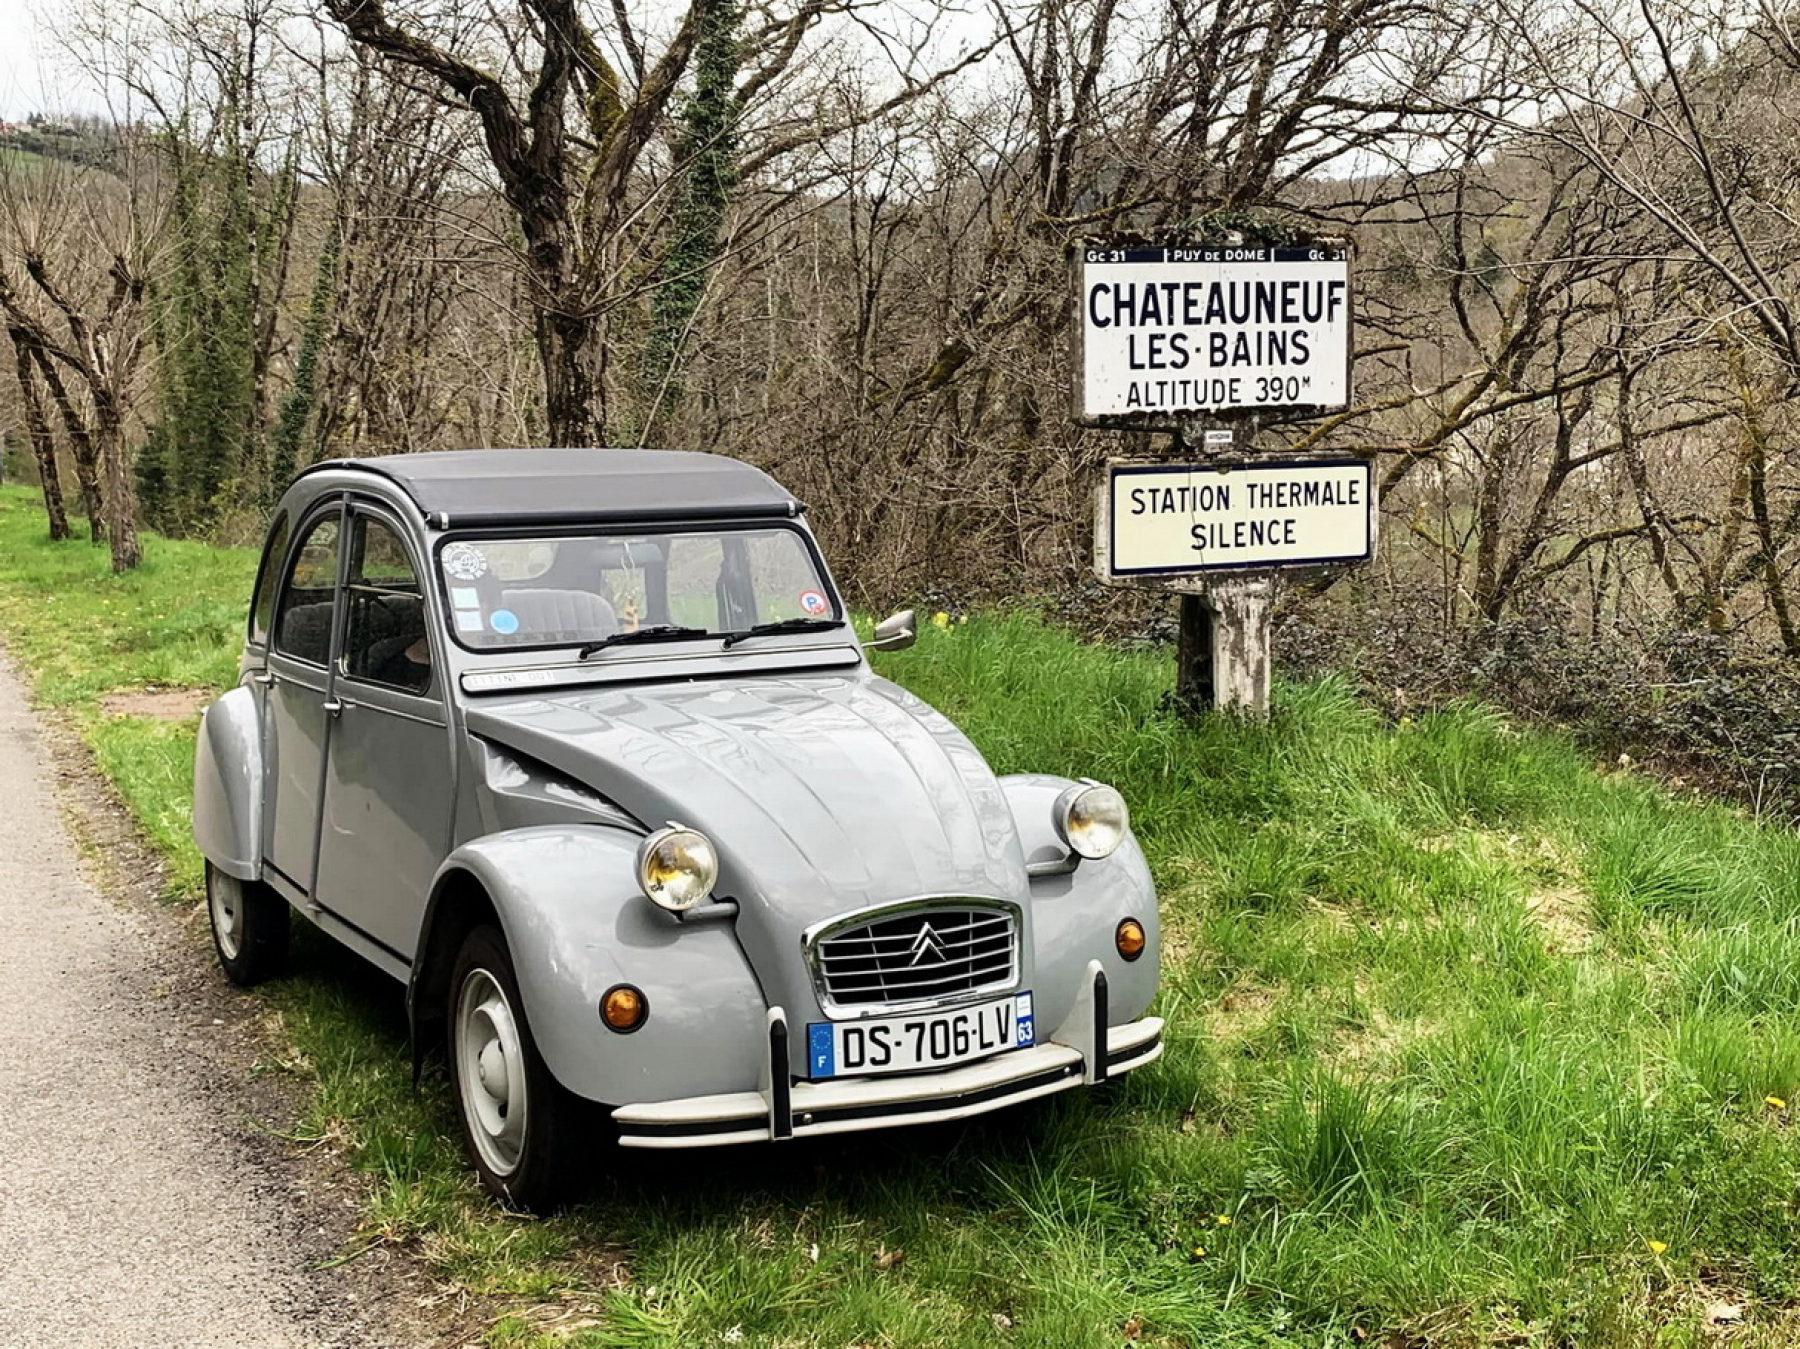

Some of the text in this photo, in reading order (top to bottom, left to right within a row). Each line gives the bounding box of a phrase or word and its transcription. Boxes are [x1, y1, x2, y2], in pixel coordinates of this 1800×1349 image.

[1109, 250, 1126, 262] 31
[1173, 250, 1201, 261] PUY
[1332, 249, 1346, 260] 31
[1089, 281, 1345, 328] CHATEAUNEUF
[1126, 378, 1241, 408] ALTITUDE
[1131, 480, 1359, 514] STATION THERMALE
[1191, 519, 1296, 550] SILENCE
[818, 1055, 827, 1068] F
[1018, 1020, 1033, 1042] 63
